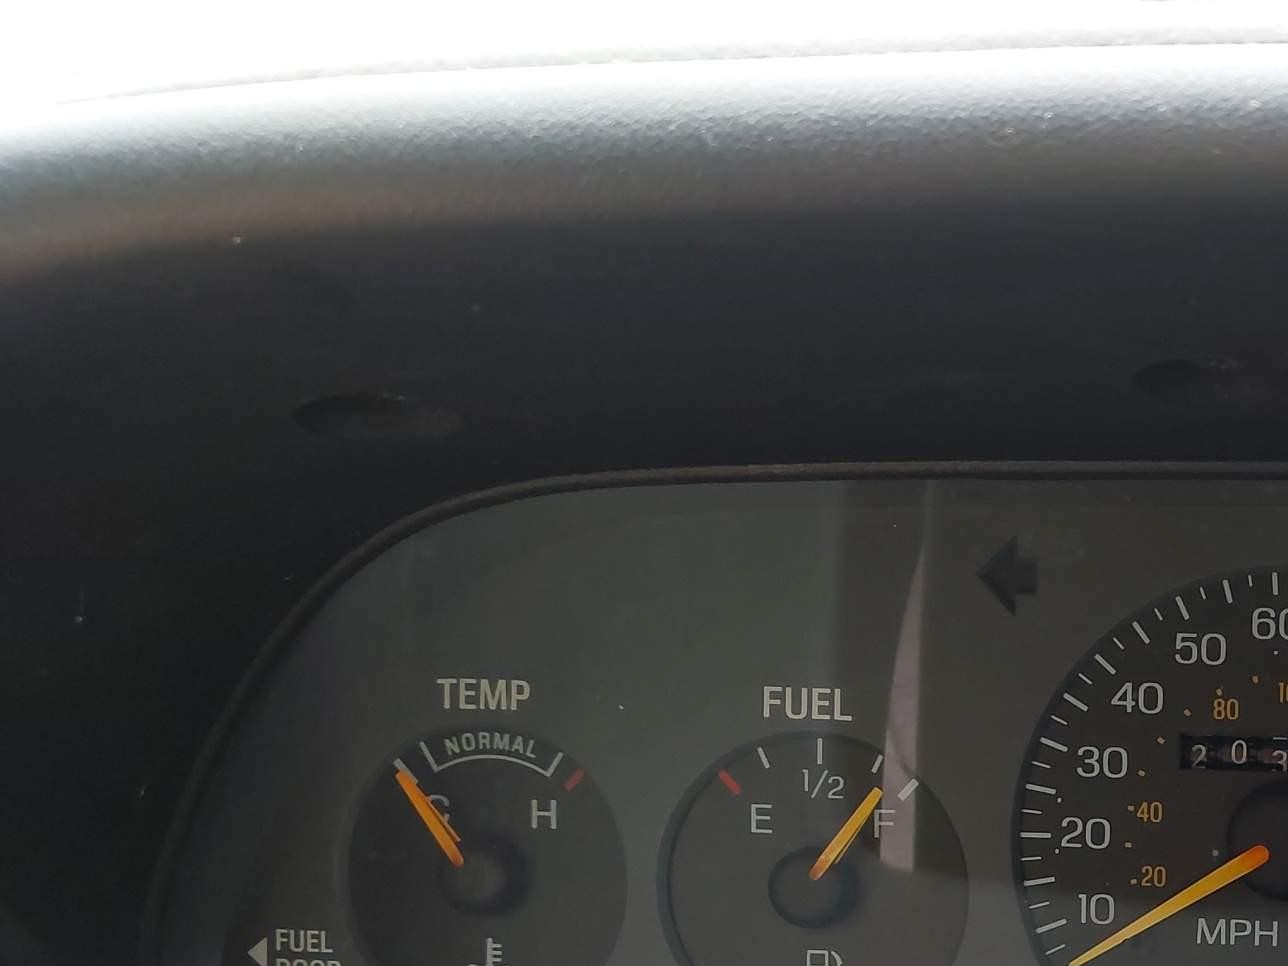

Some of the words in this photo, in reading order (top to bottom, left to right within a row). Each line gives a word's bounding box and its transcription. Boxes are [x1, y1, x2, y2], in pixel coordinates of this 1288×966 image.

[1175, 633, 1226, 665] 50
[437, 679, 530, 710] TEMP
[764, 686, 852, 721] FUEL
[1111, 683, 1163, 713] 40
[1214, 699, 1238, 720] 80
[444, 732, 537, 758] NORMAL
[1077, 747, 1127, 778] 30
[802, 769, 845, 799] 1/2
[532, 800, 556, 829] H
[751, 804, 772, 833] E
[873, 809, 896, 838] F
[1137, 802, 1162, 822] 40
[1061, 817, 1110, 849] 20
[1142, 866, 1165, 886] 20
[1079, 894, 1114, 924] 10
[276, 929, 333, 952] FUEL
[1197, 918, 1277, 946] MPH
